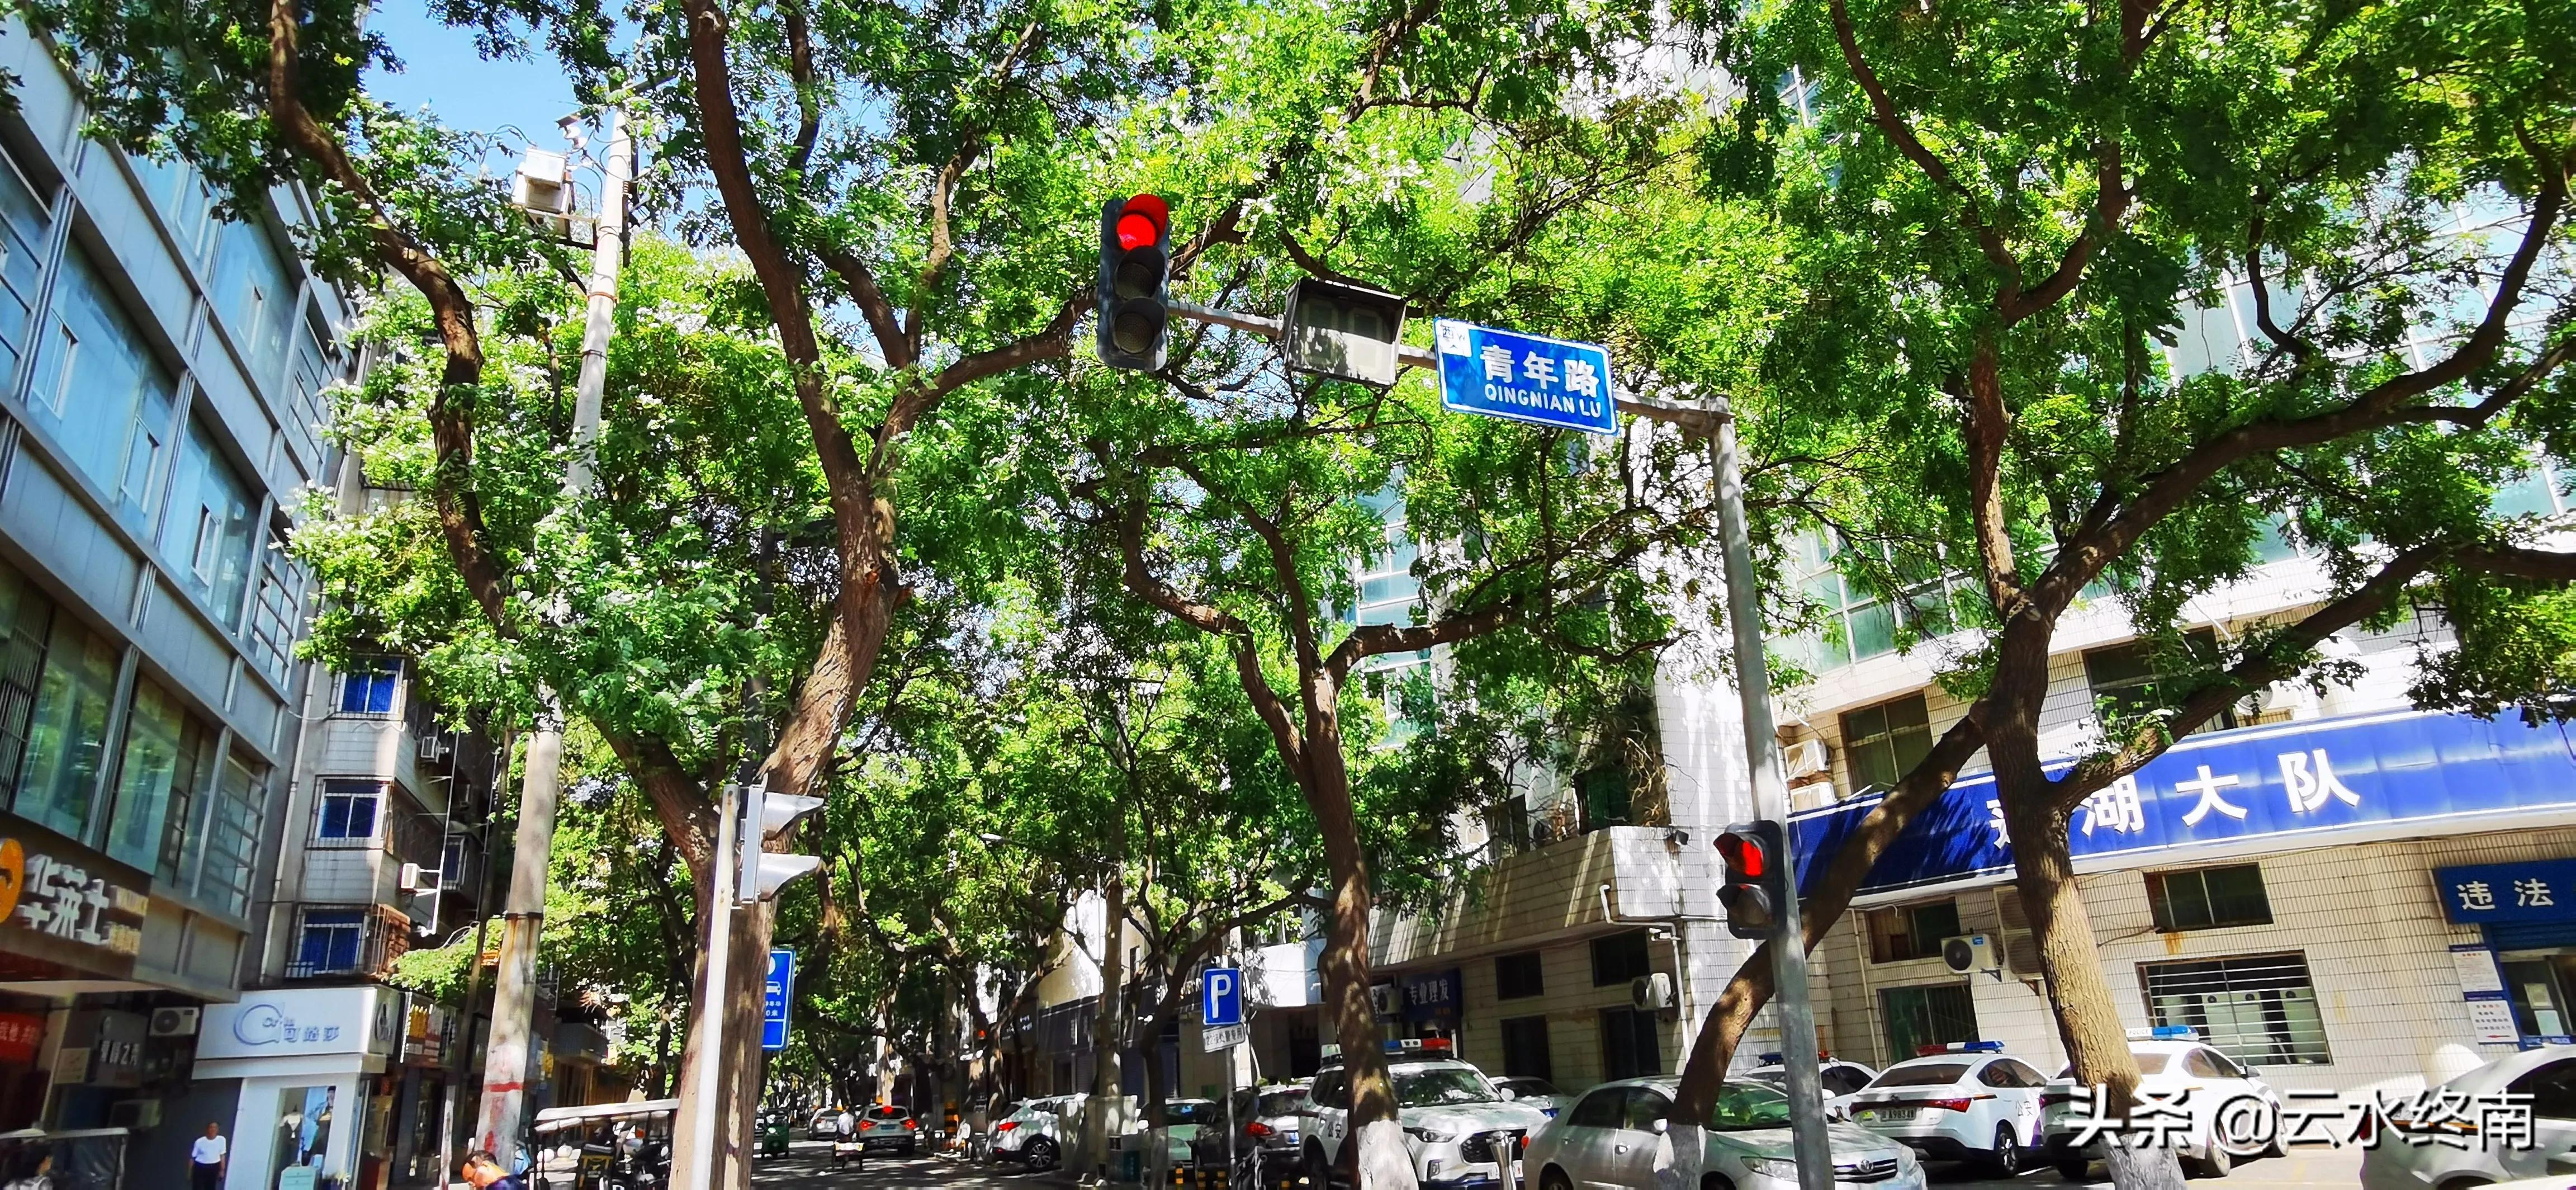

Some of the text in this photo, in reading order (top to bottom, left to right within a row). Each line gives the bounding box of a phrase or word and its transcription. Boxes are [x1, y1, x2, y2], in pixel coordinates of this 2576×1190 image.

[1480, 344, 1599, 398] 青年路
[1484, 384, 1602, 418] QINGNIAN LU
[17, 854, 110, 946] 华莱士
[2456, 878, 2554, 910] 违法
[1210, 974, 1232, 1019] P
[1409, 978, 1449, 1006] 专业理发
[2015, 1100, 2033, 1117] 公安
[1327, 1121, 1342, 1140] 公安
